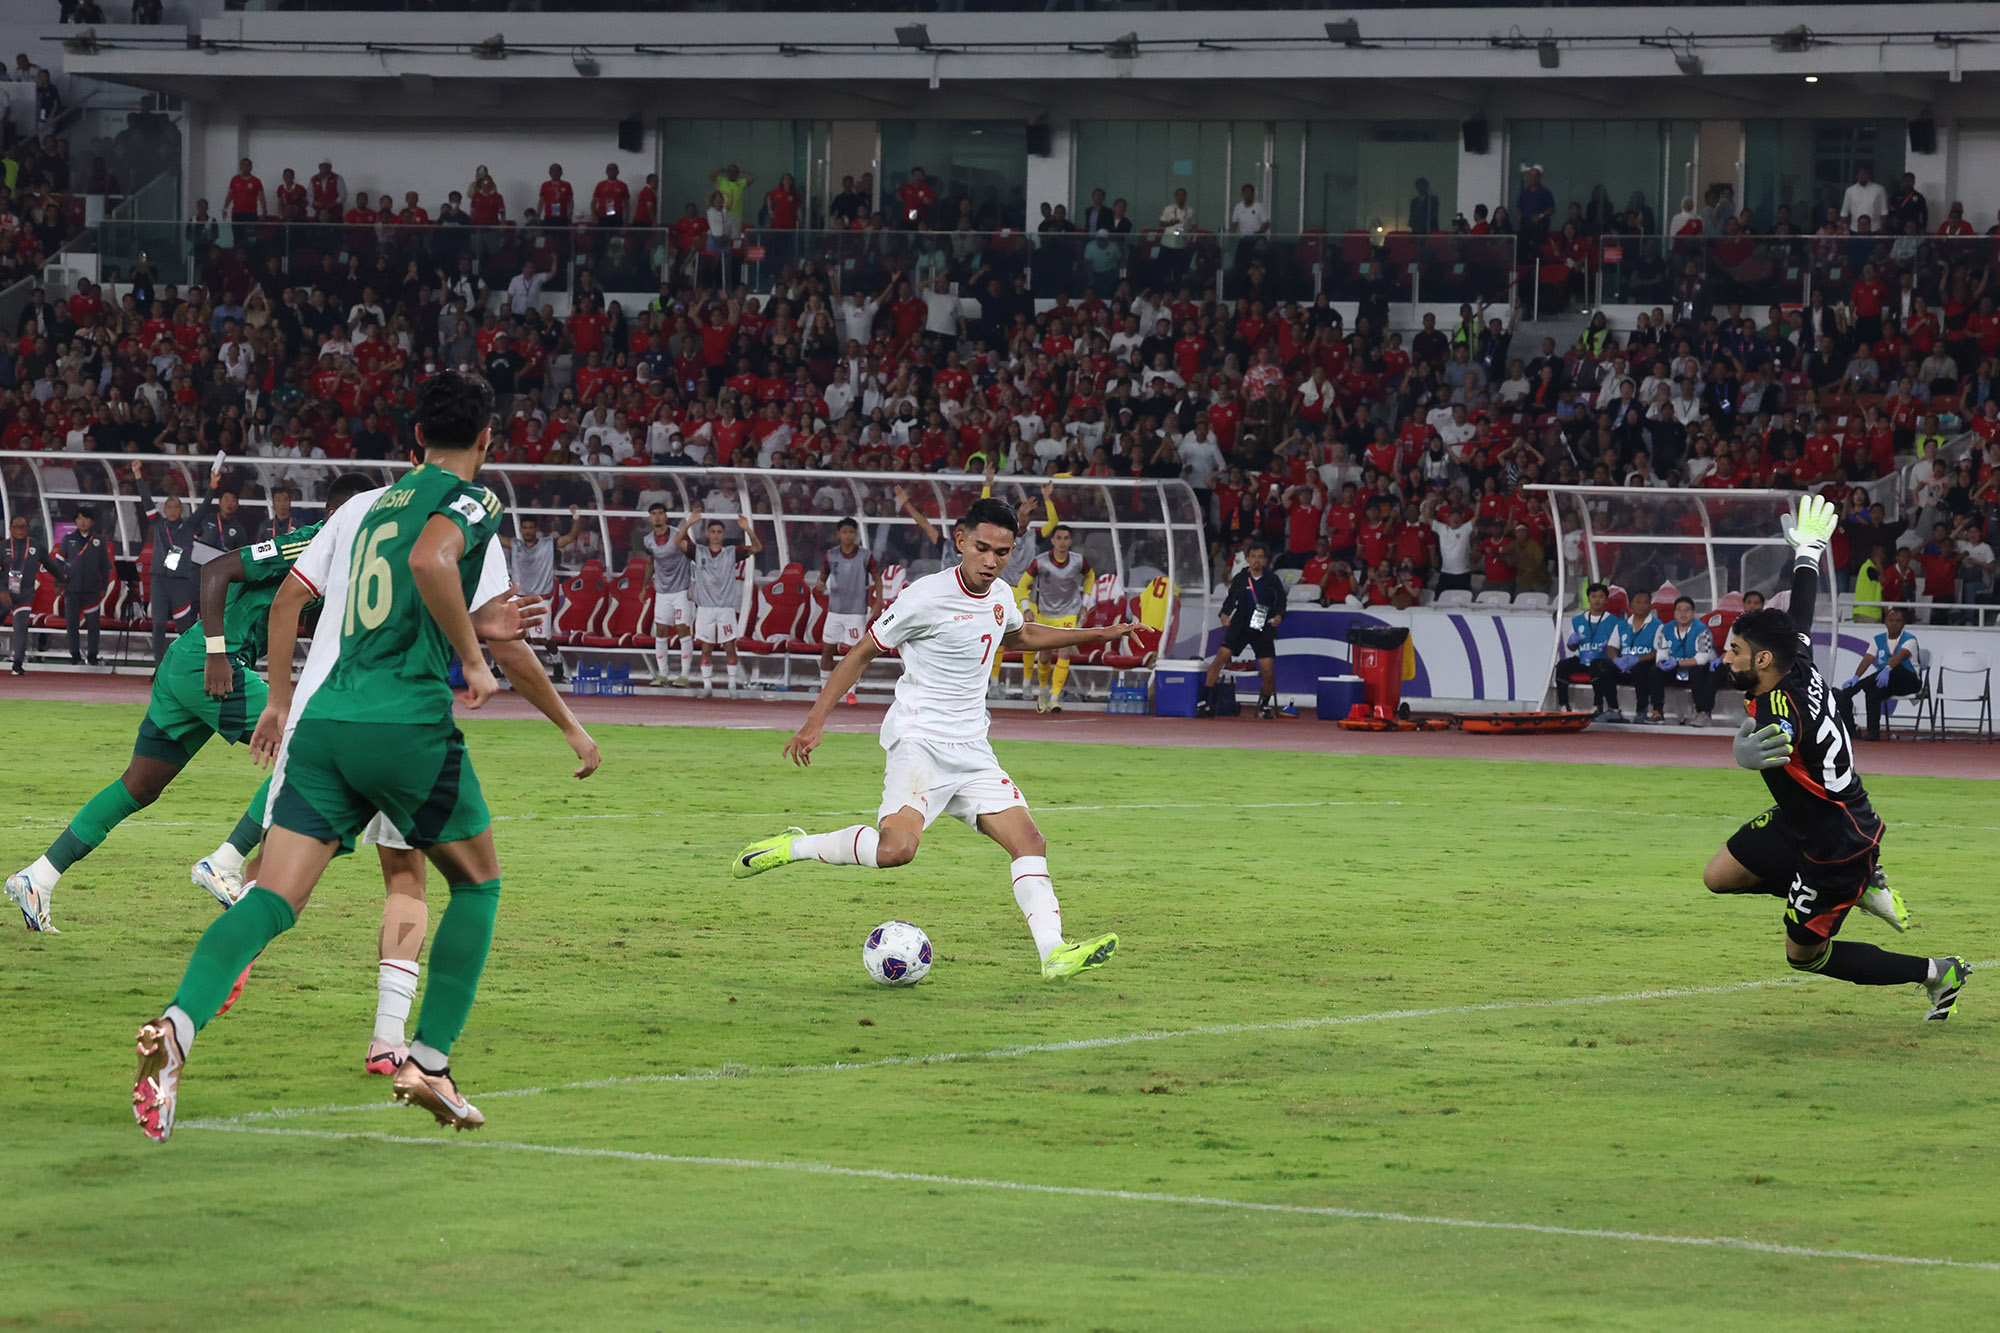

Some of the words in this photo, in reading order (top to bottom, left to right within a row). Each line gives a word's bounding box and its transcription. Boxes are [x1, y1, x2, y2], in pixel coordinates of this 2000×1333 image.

[344, 521, 398, 637] 16
[722, 624, 733, 637] 14
[848, 627, 860, 639] 10
[980, 633, 992, 665] 7
